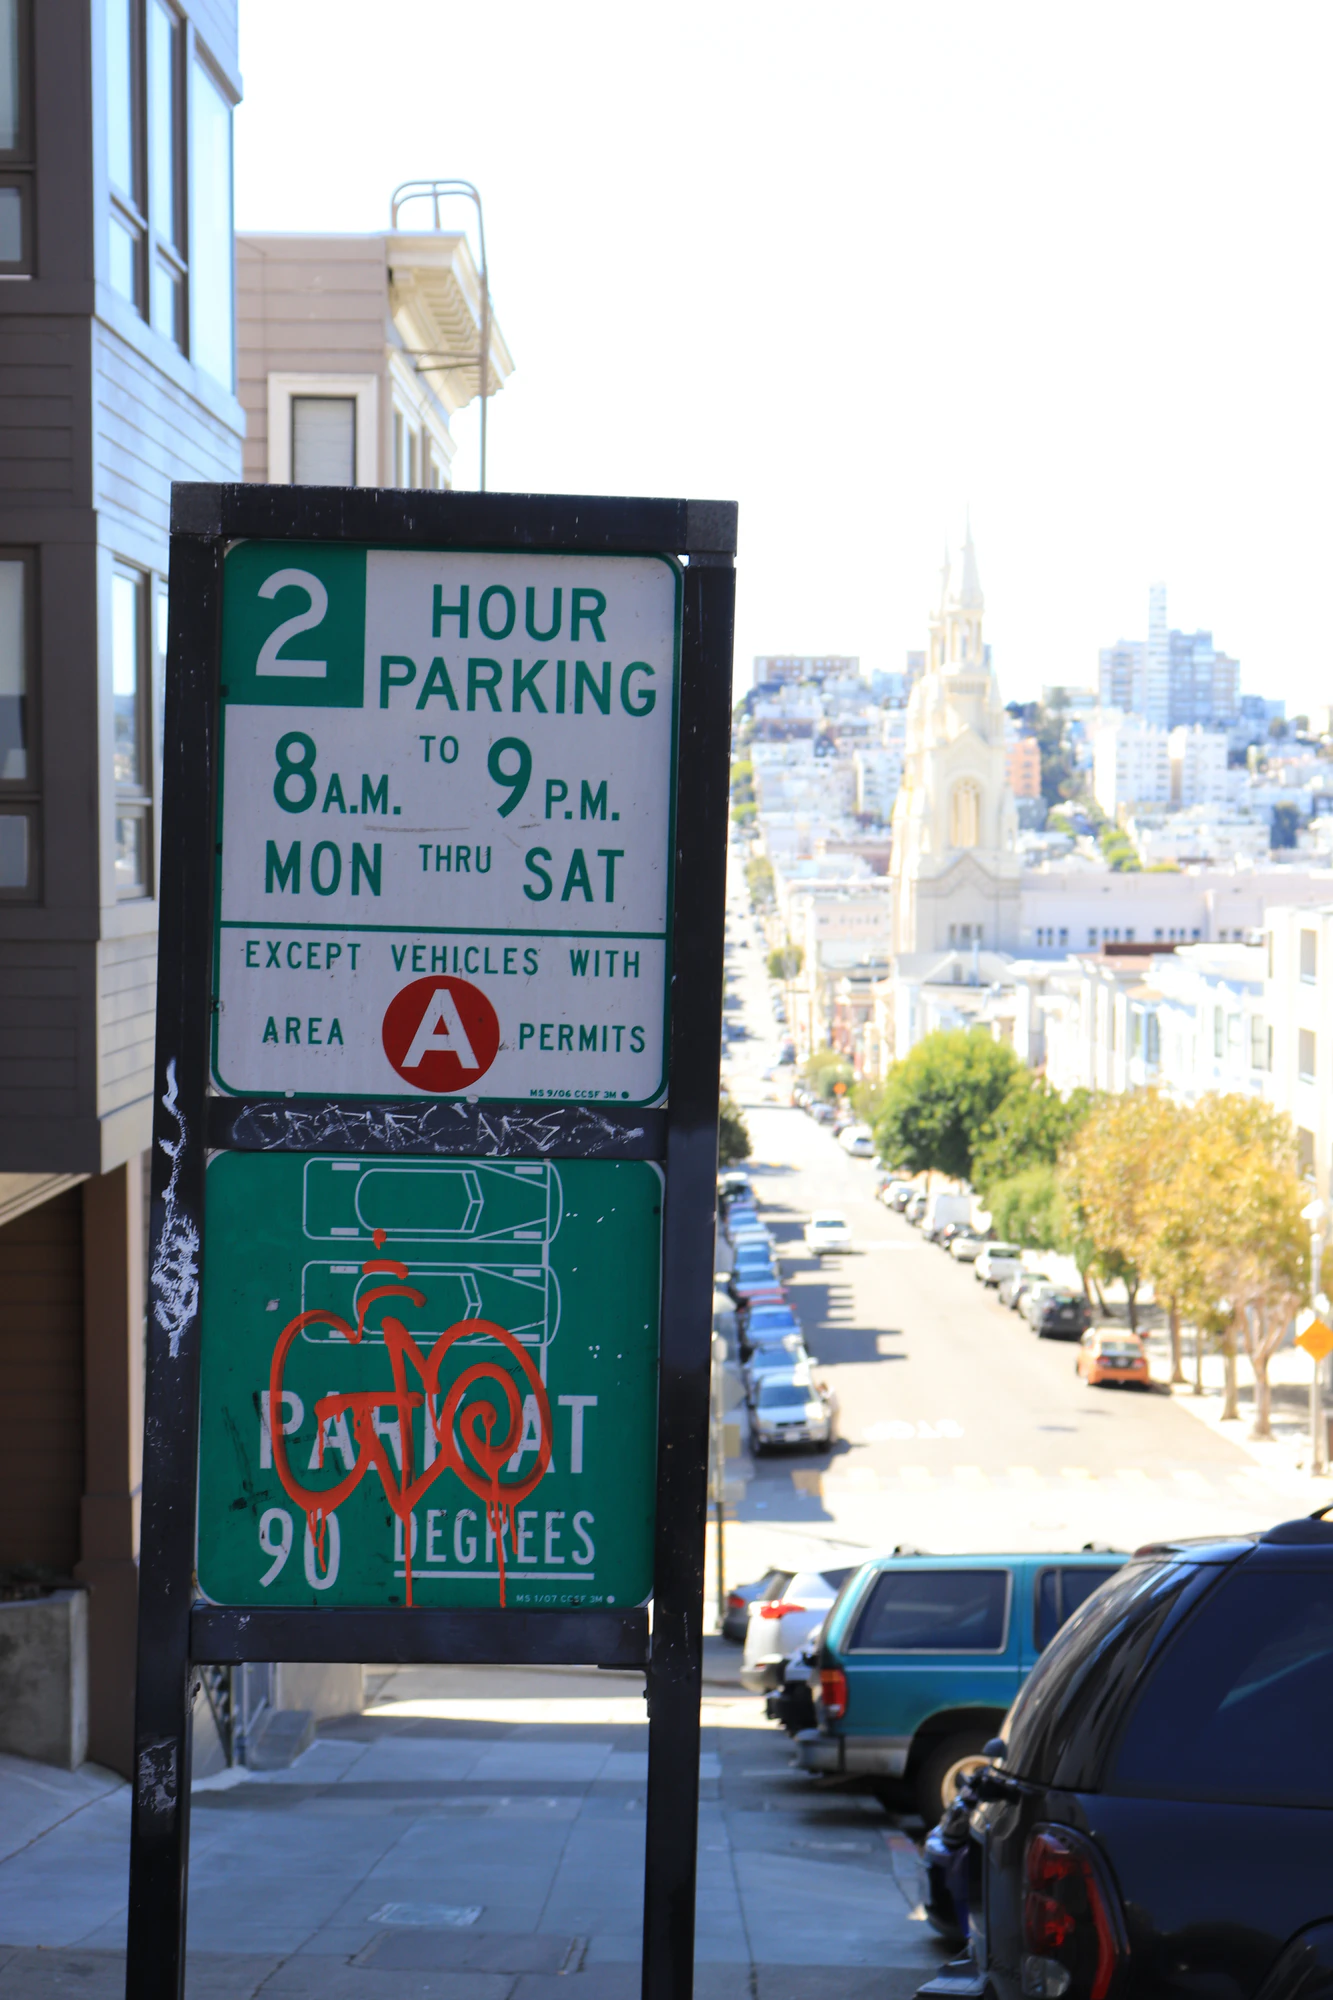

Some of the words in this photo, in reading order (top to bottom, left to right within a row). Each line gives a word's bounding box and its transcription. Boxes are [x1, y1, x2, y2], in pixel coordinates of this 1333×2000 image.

[256, 568, 328, 677] 2
[432, 584, 607, 642] HOUR
[379, 655, 656, 717] PARKING
[420, 735, 459, 763] TO
[265, 840, 382, 896] MON
[419, 844, 491, 873] THRU
[523, 847, 624, 903] SAT
[245, 940, 361, 971] EXCEPT
[391, 944, 538, 975] VEHICLES
[570, 949, 640, 978] WITH
[262, 1016, 344, 1046] AREA
[400, 988, 480, 1069] A
[519, 1023, 645, 1053] PERMITS
[530, 1089, 544, 1097] MS
[547, 1089, 571, 1098] 9/06
[575, 1090, 600, 1098] CCSF
[604, 1091, 617, 1099] 3M
[506, 1395, 598, 1474] AT
[259, 1507, 340, 1590] 90
[394, 1508, 595, 1565] DEGREES
